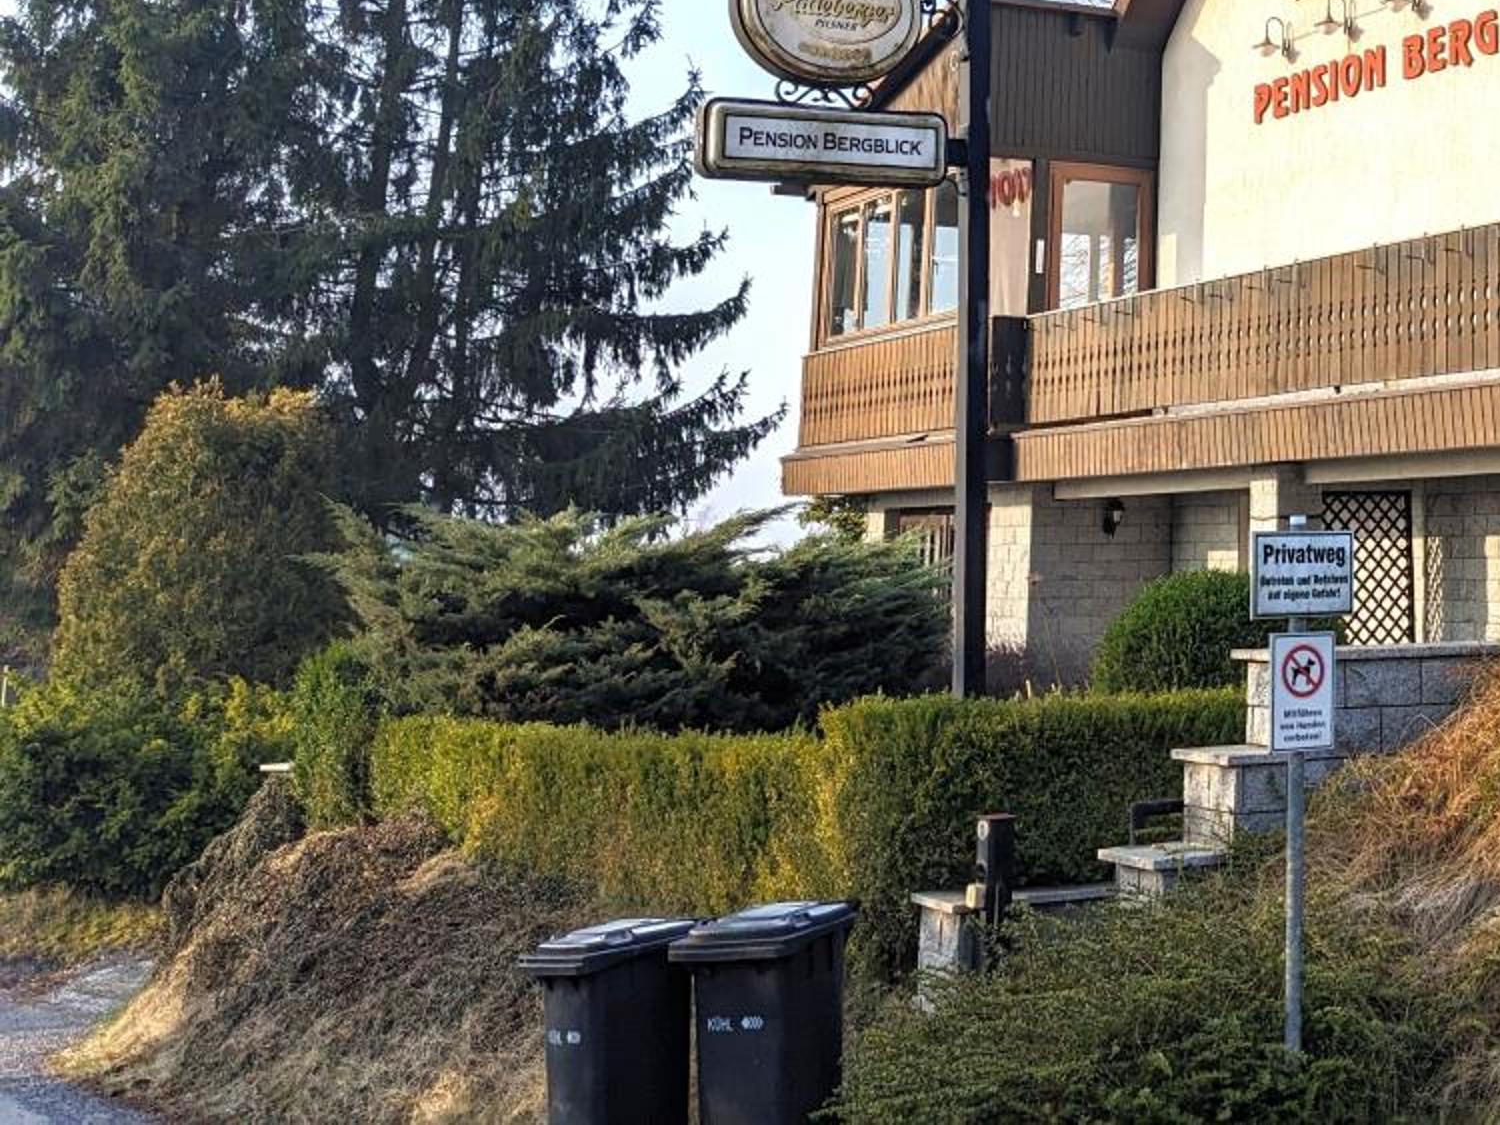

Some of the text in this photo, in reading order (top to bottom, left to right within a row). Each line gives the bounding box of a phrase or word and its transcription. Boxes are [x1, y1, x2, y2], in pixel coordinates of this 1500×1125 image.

[1252, 43, 1387, 125] PENSION
[739, 127, 922, 156] PENSION BERGBLICK
[1263, 543, 1345, 568] Privatweg
